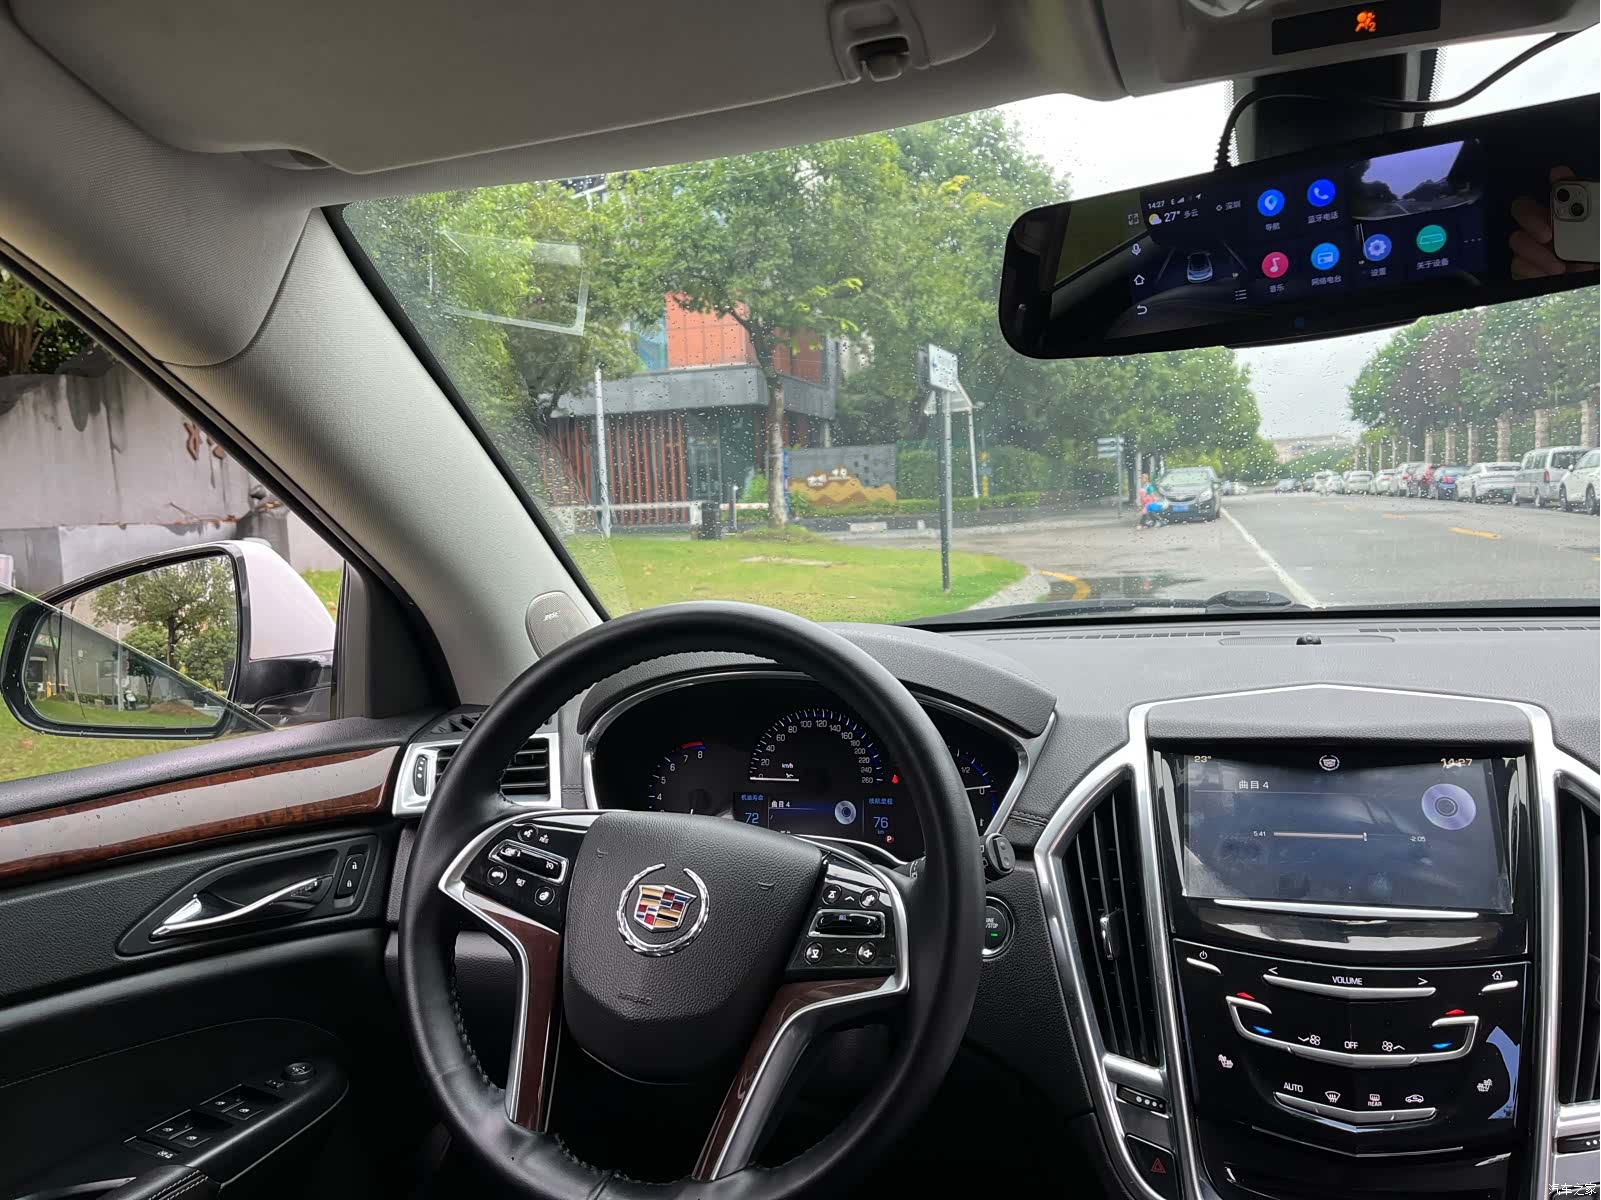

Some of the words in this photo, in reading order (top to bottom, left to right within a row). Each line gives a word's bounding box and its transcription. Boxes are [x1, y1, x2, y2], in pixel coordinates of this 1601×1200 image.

[1368, 22, 1376, 32] 2
[1148, 200, 1165, 209] 14:27
[1164, 210, 1181, 222] 27°
[1416, 258, 1449, 270] 关于设备
[788, 726, 798, 734] 80
[829, 724, 842, 732] 140
[776, 734, 786, 742] 60
[840, 732, 853, 740] 160
[766, 744, 776, 752] 40
[698, 750, 703, 758] 8
[760, 758, 770, 766] 20
[1440, 758, 1472, 768] 14:27
[670, 763, 676, 772] 6
[661, 776, 666, 784] 5
[1238, 780, 1259, 790] 曲目
[744, 812, 760, 824] 72
[873, 816, 889, 829] 76
[1332, 976, 1363, 986] VOLUME
[1344, 1040, 1358, 1050] OFF
[1283, 1082, 1304, 1093] AUTO
